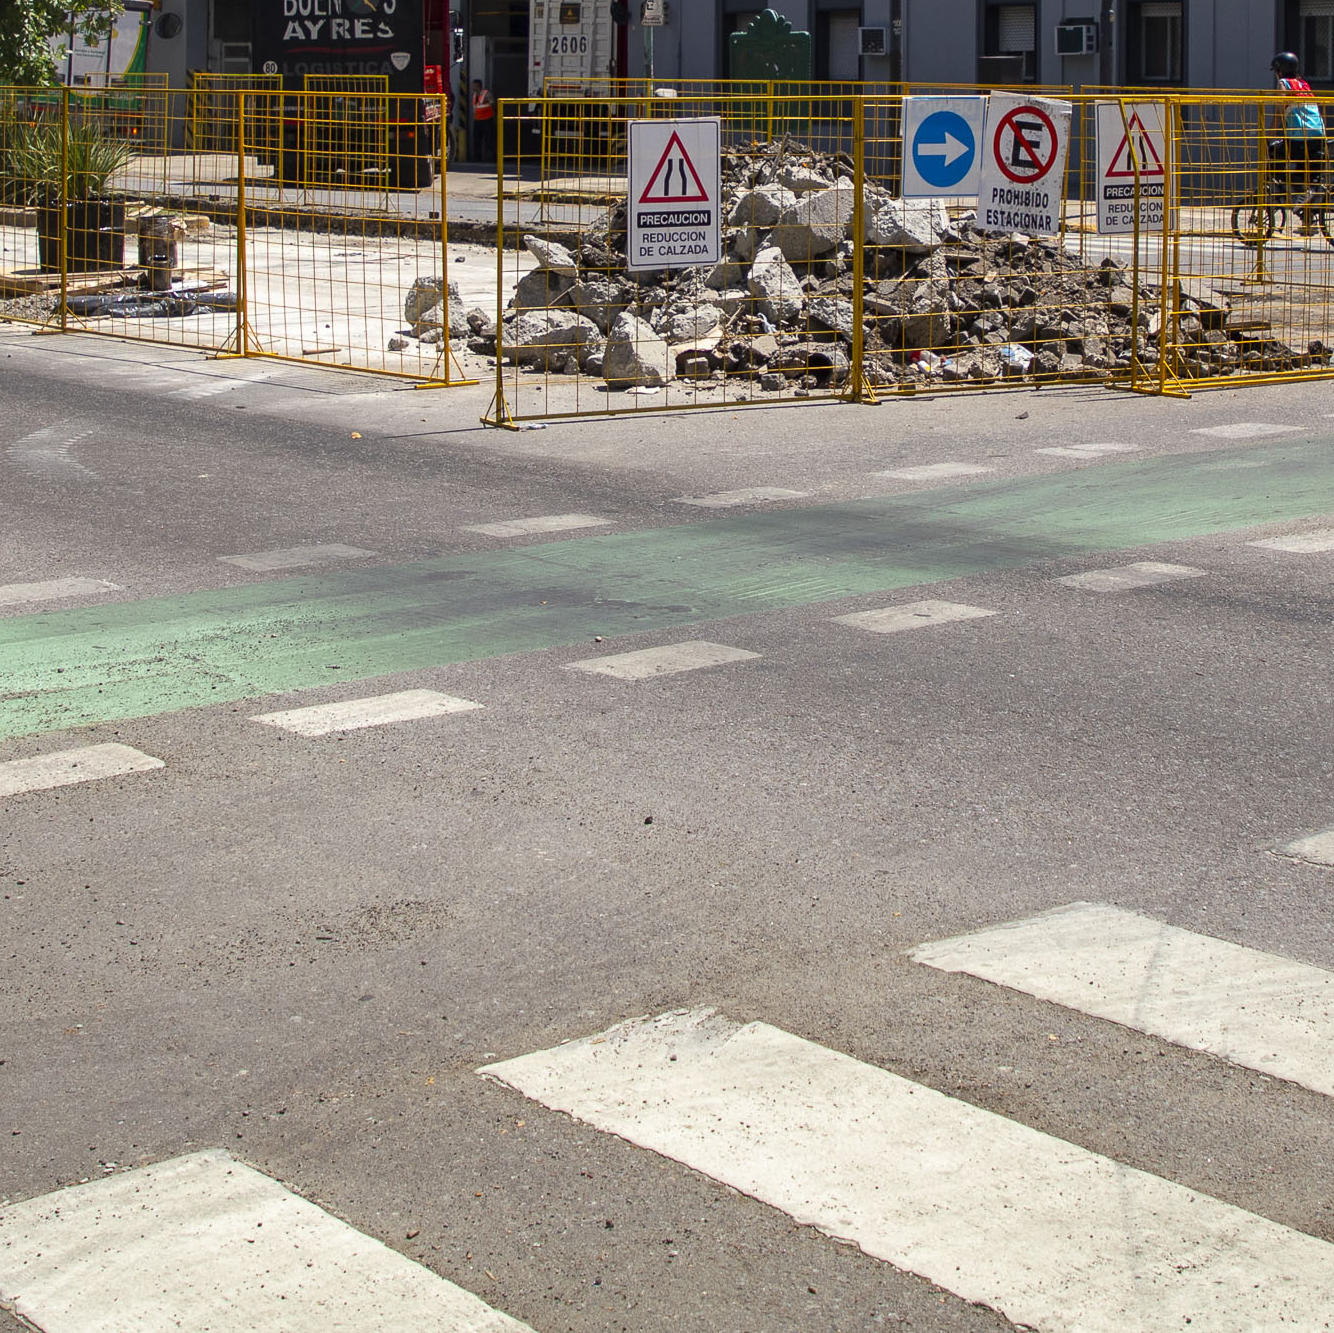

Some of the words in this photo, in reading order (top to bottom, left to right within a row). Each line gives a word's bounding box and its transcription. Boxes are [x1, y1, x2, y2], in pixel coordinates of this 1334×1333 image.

[551, 36, 587, 54] 2606
[264, 62, 277, 74] 80
[282, 61, 396, 77] LOGISTICA
[991, 186, 1050, 209] PROHIBIDO
[1108, 202, 1163, 214] REDUCION
[640, 213, 708, 226] PRECAUCION
[986, 209, 1052, 232] ESTACIONAR
[1105, 216, 1118, 226] DE
[1121, 214, 1164, 226] CAZADA
[642, 231, 706, 244] REDUCCION
[639, 246, 654, 257] DE
[658, 244, 709, 257] CALZADA
